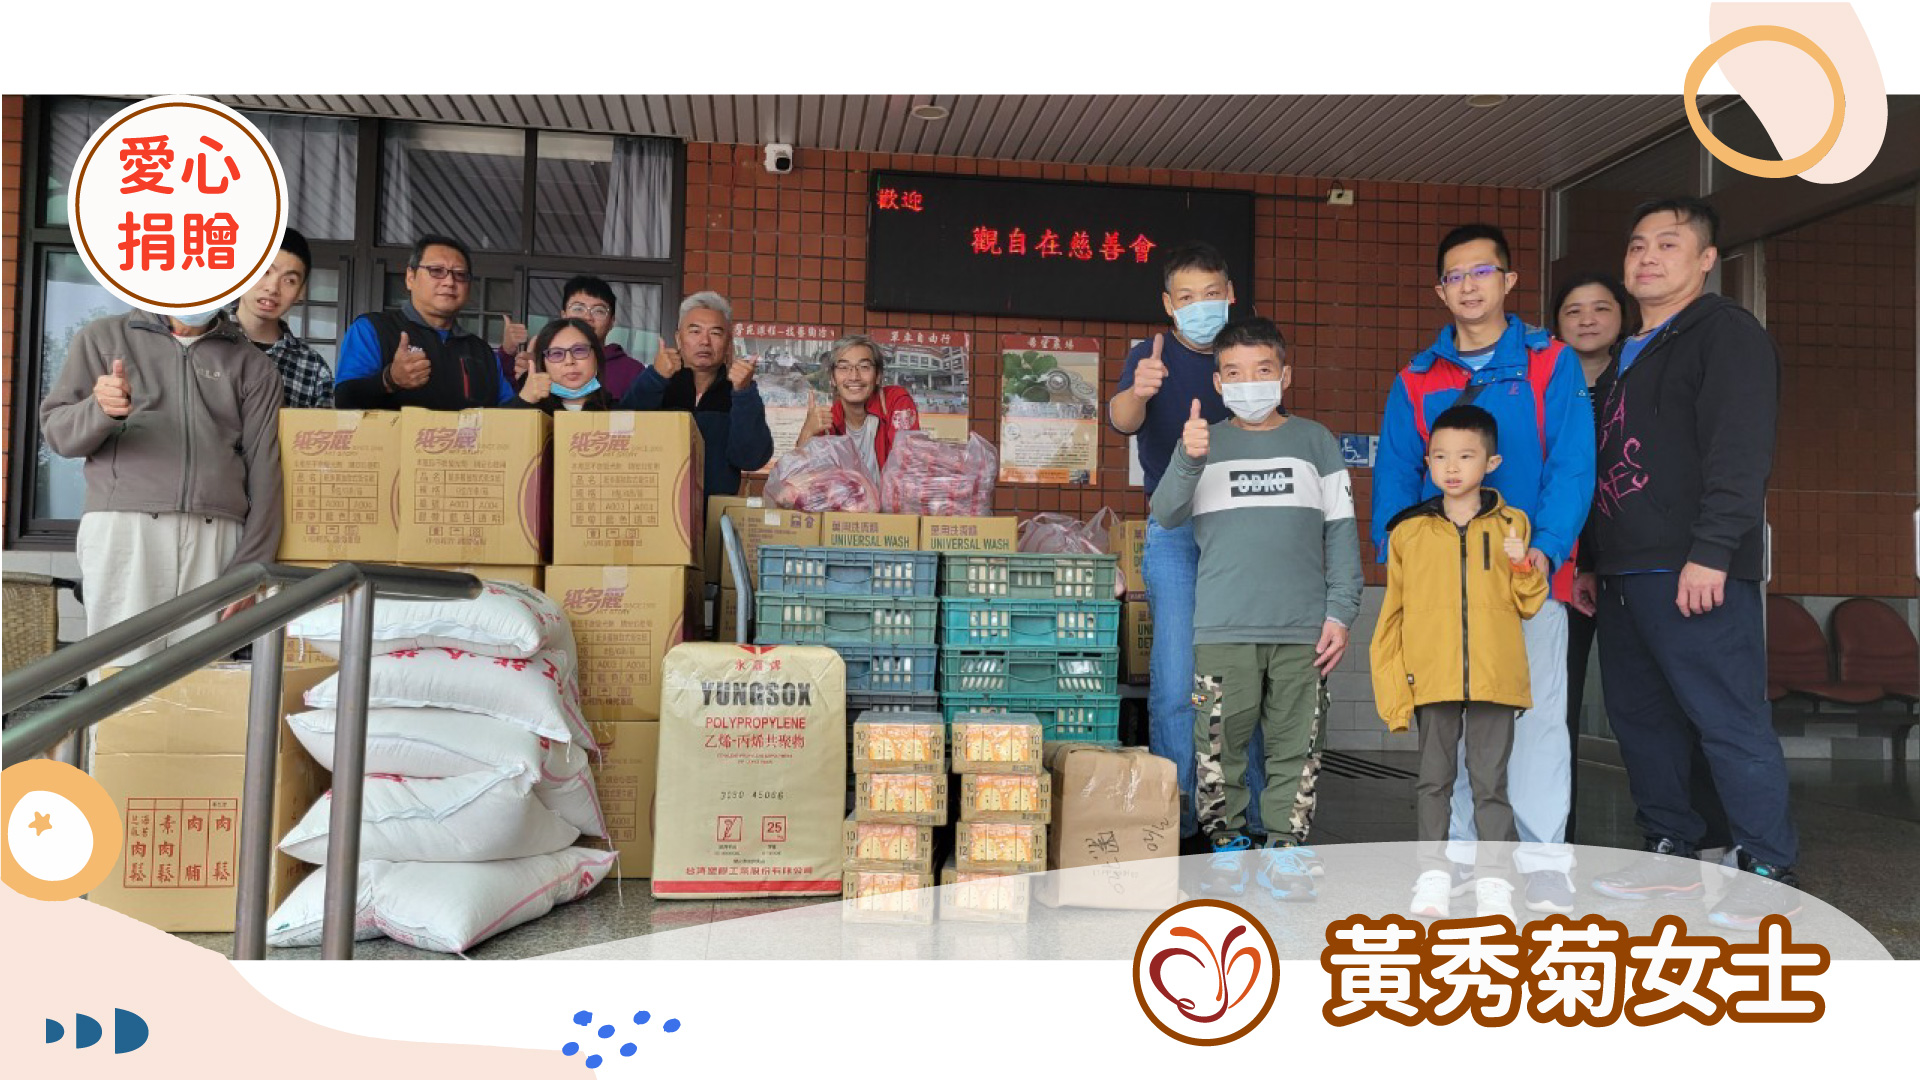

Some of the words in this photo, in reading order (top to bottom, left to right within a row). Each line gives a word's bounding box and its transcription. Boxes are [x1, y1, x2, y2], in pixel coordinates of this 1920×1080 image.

[876, 187, 924, 212] 歡迎
[971, 225, 1156, 264] 觀自在慈善會
[831, 533, 882, 547] UNIVERSAL
[884, 535, 910, 548] WASH
[930, 538, 981, 550] UNIVERSAL
[983, 538, 1010, 550] WASH
[701, 682, 812, 706] YUNGSOX
[705, 716, 806, 729] POLYPROPYLENE
[767, 821, 783, 834] 25
[212, 814, 232, 882] 肉鬆
[960, 846, 968, 856] 12
[1034, 848, 1043, 859] 12
